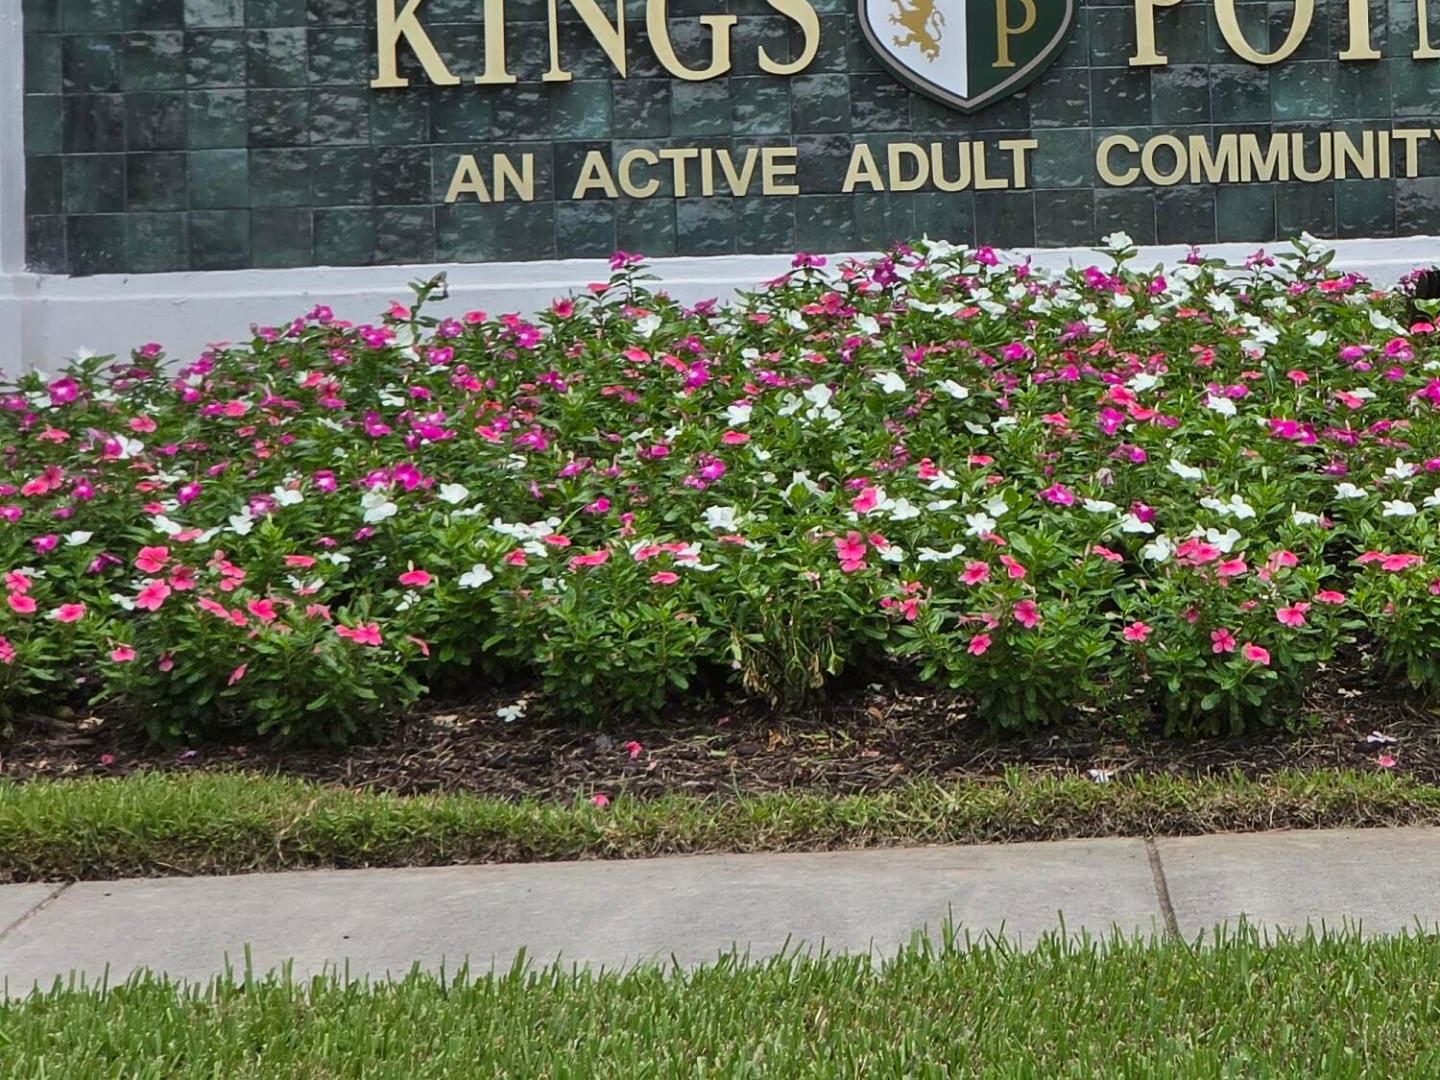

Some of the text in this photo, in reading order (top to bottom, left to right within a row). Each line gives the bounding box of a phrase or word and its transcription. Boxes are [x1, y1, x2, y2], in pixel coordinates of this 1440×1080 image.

[444, 153, 536, 203] AN
[572, 146, 800, 200] ACTIVE
[842, 139, 1038, 193] ADULT
